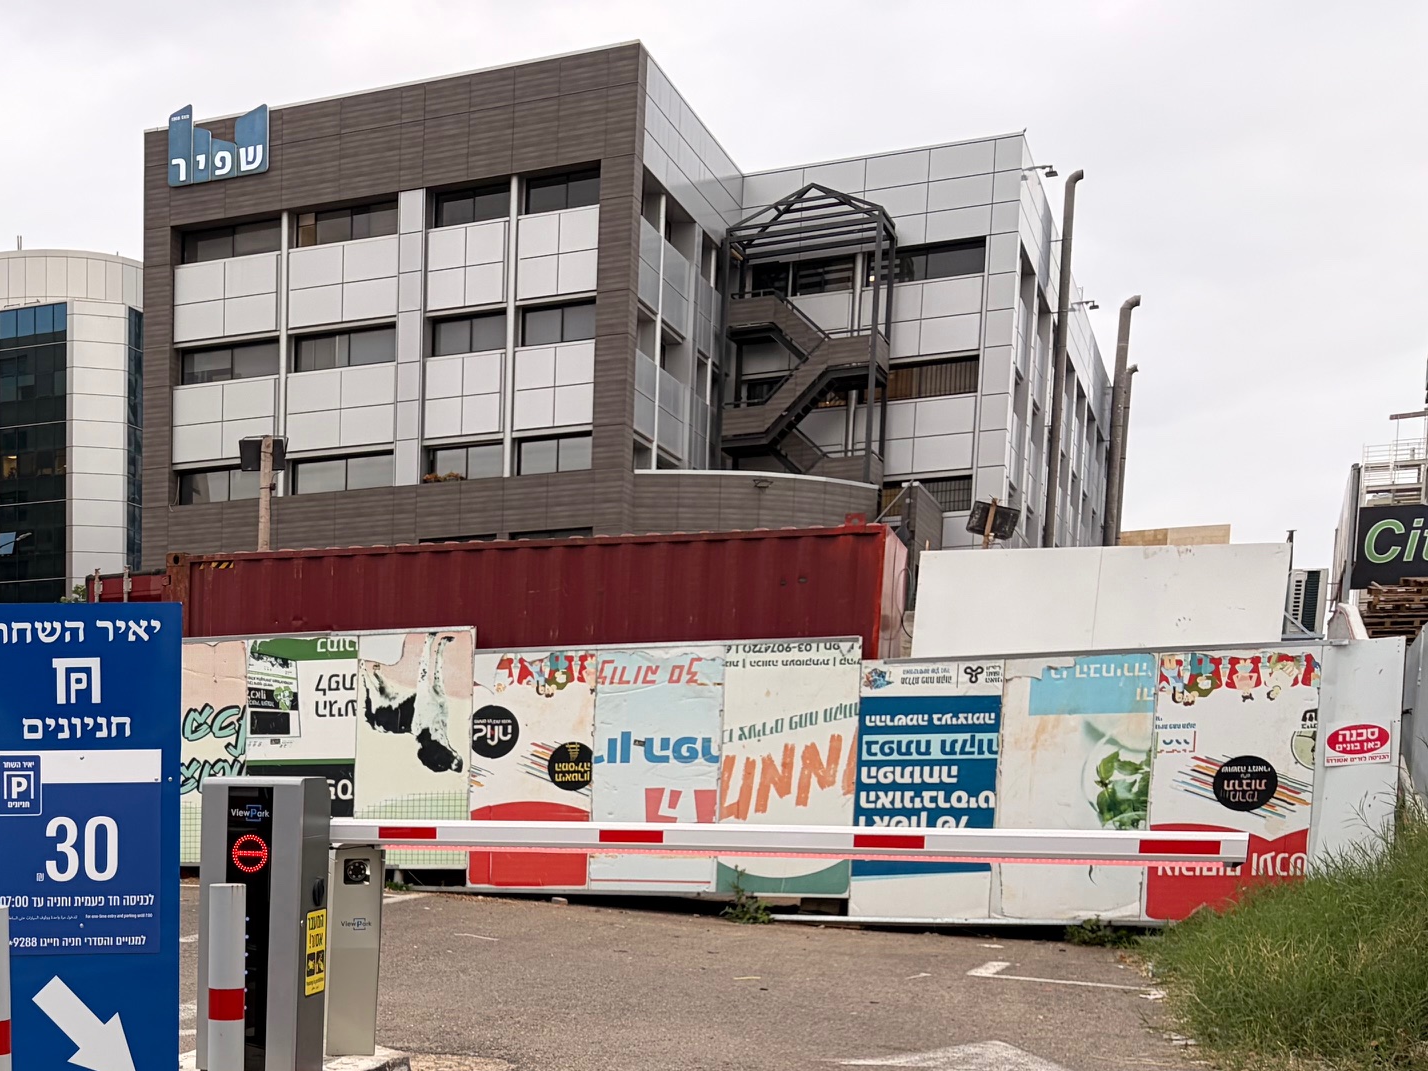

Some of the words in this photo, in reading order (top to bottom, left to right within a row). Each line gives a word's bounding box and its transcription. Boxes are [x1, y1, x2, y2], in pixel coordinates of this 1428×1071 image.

[171, 144, 264, 182] שפיר
[96, 618, 162, 642] יאיר
[316, 700, 358, 718] הגיע
[866, 714, 928, 726] ההרשמה
[933, 712, 996, 726] בעיצומה
[22, 716, 131, 740] חניונים
[738, 718, 784, 744] צעירים
[789, 710, 818, 731] פתח
[1338, 728, 1379, 742] סכנה
[865, 740, 932, 758] בפתח
[1335, 743, 1360, 751] בונים
[1364, 741, 1381, 751] כאן
[555, 762, 590, 772] המסילה
[1248, 764, 1270, 772] דמארי
[555, 771, 590, 782] תיאטרון
[861, 766, 958, 784] הפתוחה
[1224, 778, 1267, 790] תרבות
[1230, 790, 1258, 802] מרכז
[7, 800, 30, 808] חניונים
[231, 807, 270, 819] ViewPark
[45, 816, 118, 882] 30
[0, 896, 29, 908] 07:00
[32, 896, 44, 908] עד
[47, 896, 72, 908] וחניה
[74, 895, 104, 907] פעמית
[107, 895, 120, 906] חד
[123, 894, 154, 906] לכניסה
[340, 919, 372, 929] ViewPark
[40, 938, 60, 947] חייגו
[62, 937, 82, 946] חניה
[85, 936, 113, 946] והסדרי
[116, 936, 146, 946] למנויים
